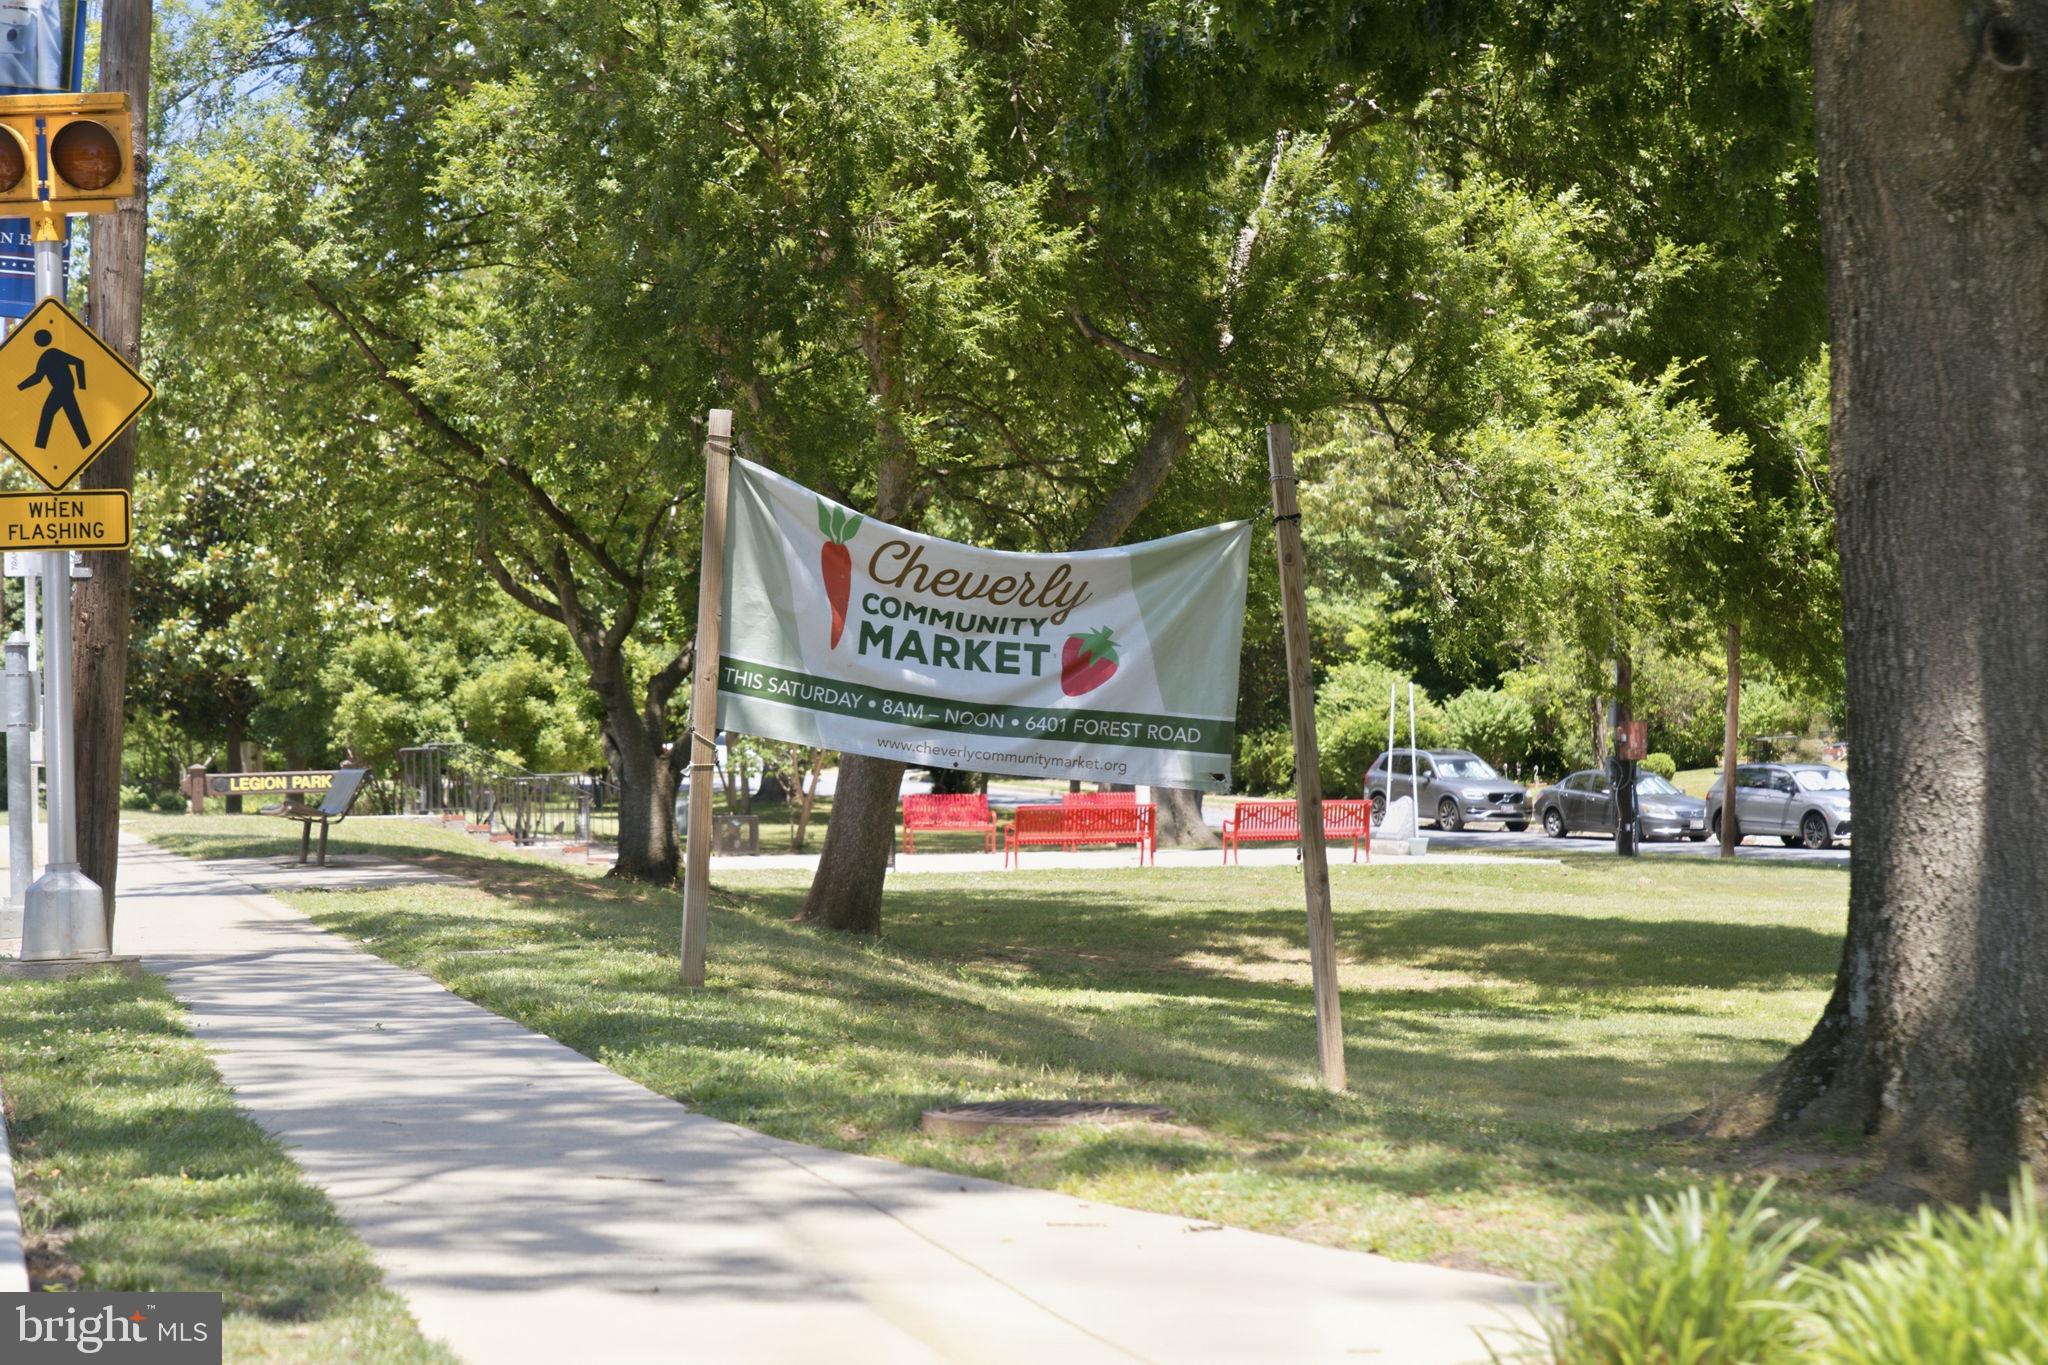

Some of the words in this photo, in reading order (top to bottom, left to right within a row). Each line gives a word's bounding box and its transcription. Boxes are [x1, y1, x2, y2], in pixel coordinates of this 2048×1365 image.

[28, 501, 84, 518] WHEN
[8, 522, 104, 540] FLASHING
[868, 540, 1093, 625] Cheverly
[862, 592, 1050, 637] COMMUNITY
[858, 620, 1050, 677] MARKET
[725, 667, 763, 690] THIS
[768, 676, 863, 709] SATURDAY
[882, 699, 924, 719] 8AM
[944, 708, 1004, 729] NOON
[1025, 716, 1066, 733] 6401
[1073, 719, 1142, 739] FOREST
[1147, 724, 1201, 743] ROAD
[877, 736, 1128, 775] www.cheverlycommunitymarket.org
[230, 775, 286, 791] LEGION
[291, 774, 333, 789] PARK
